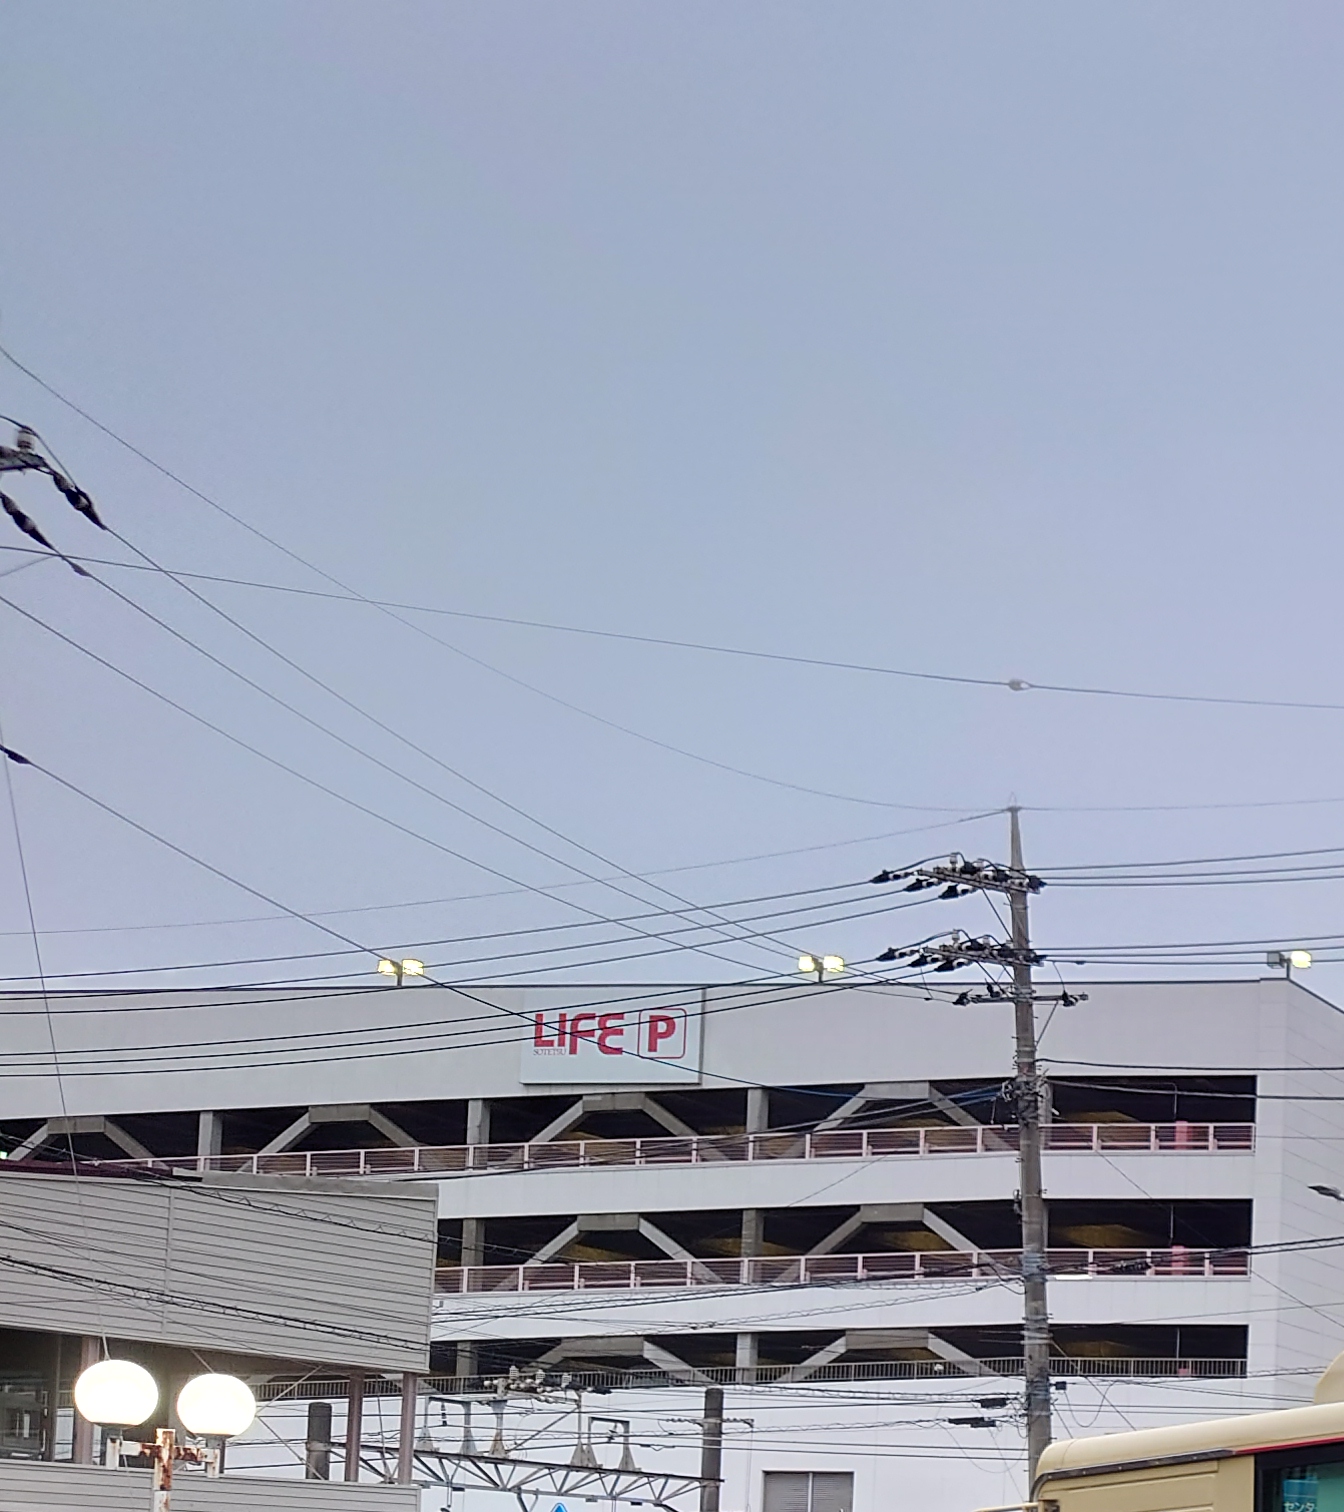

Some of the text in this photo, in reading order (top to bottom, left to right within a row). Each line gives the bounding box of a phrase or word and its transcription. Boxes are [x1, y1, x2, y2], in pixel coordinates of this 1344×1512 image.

[533, 1012, 676, 1055] LIFE P
[533, 1048, 567, 1056] SOTETSU
